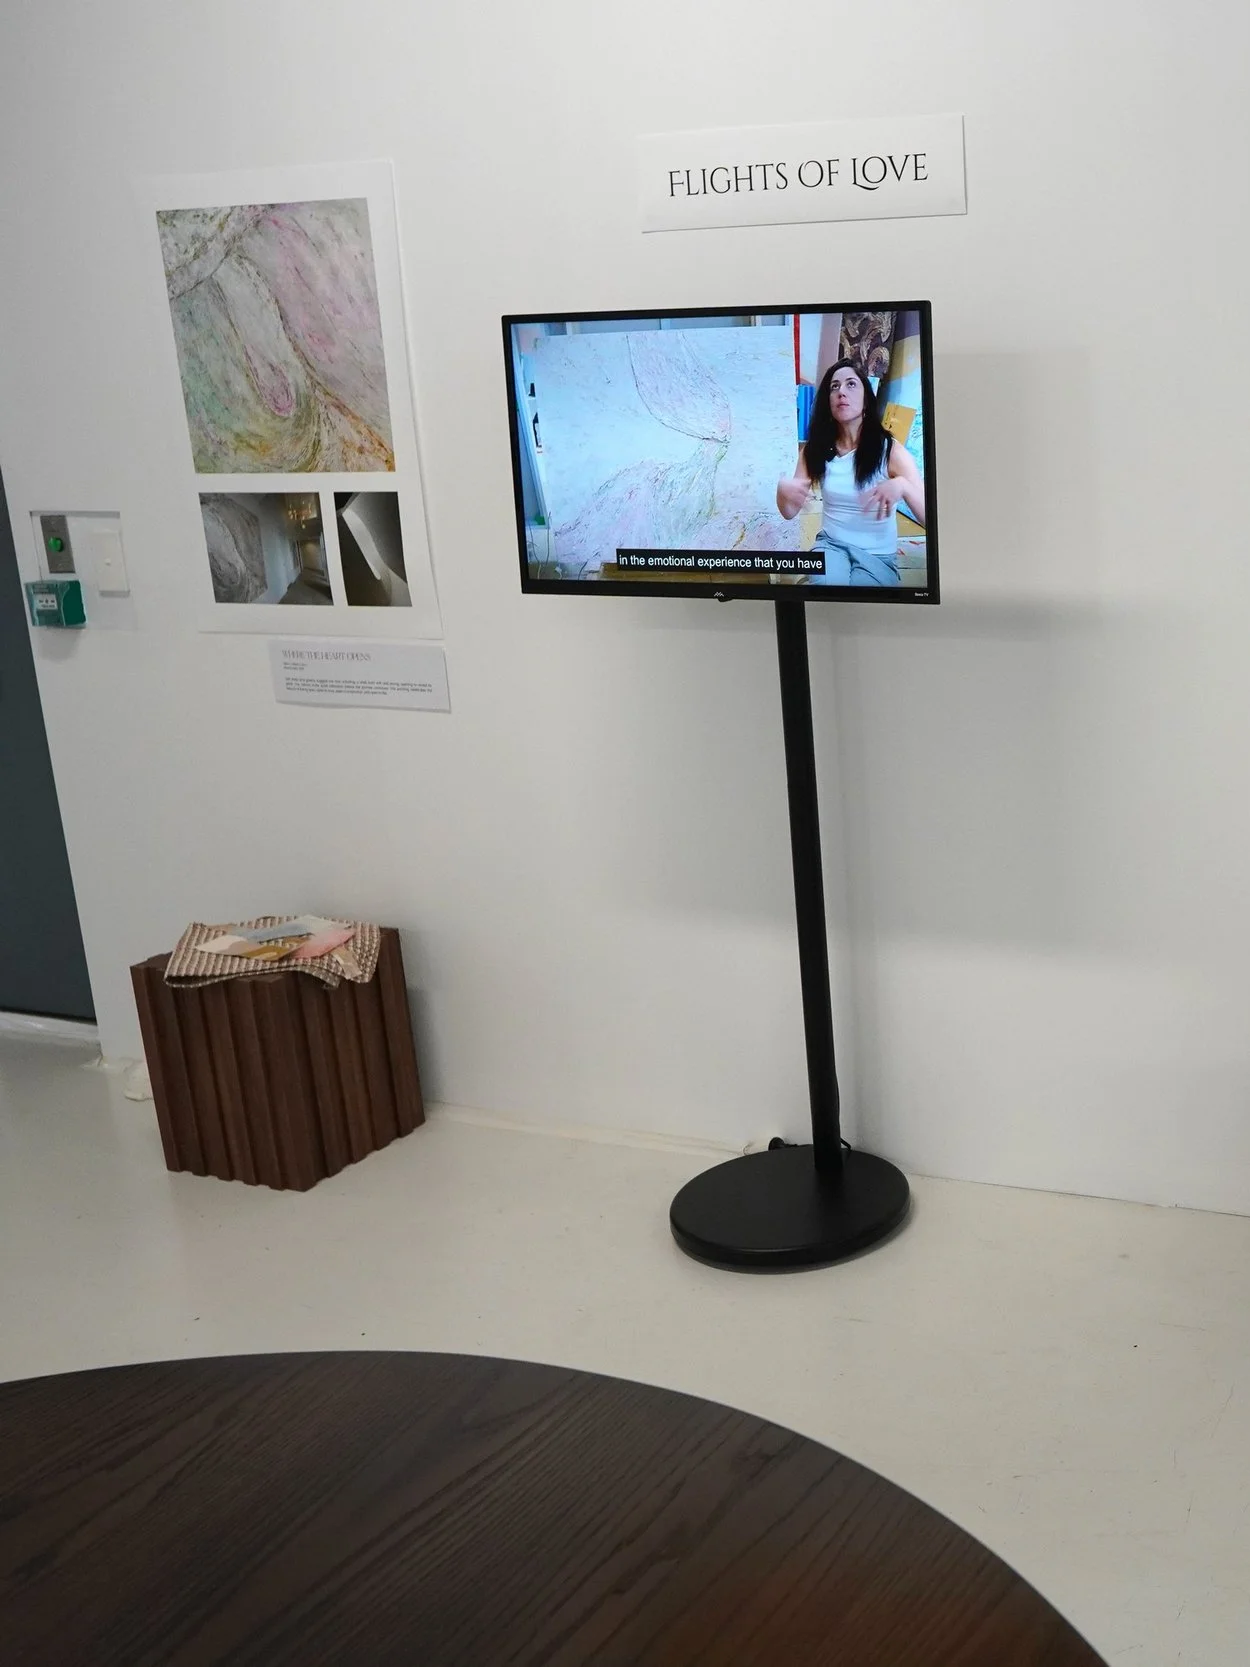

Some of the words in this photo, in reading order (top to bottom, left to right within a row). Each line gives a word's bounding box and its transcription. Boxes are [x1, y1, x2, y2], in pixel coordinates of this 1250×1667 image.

[668, 162, 788, 198] FLIGHTS
[798, 158, 840, 188] OF
[851, 152, 928, 191] LOVE
[619, 555, 628, 565] in
[630, 555, 646, 566] the
[648, 555, 696, 567] emotional
[697, 557, 752, 570] experience
[754, 557, 774, 568] that
[776, 559, 795, 571] you
[797, 558, 822, 569] have
[320, 651, 345, 661] HEART
[346, 652, 372, 662] OPENS
